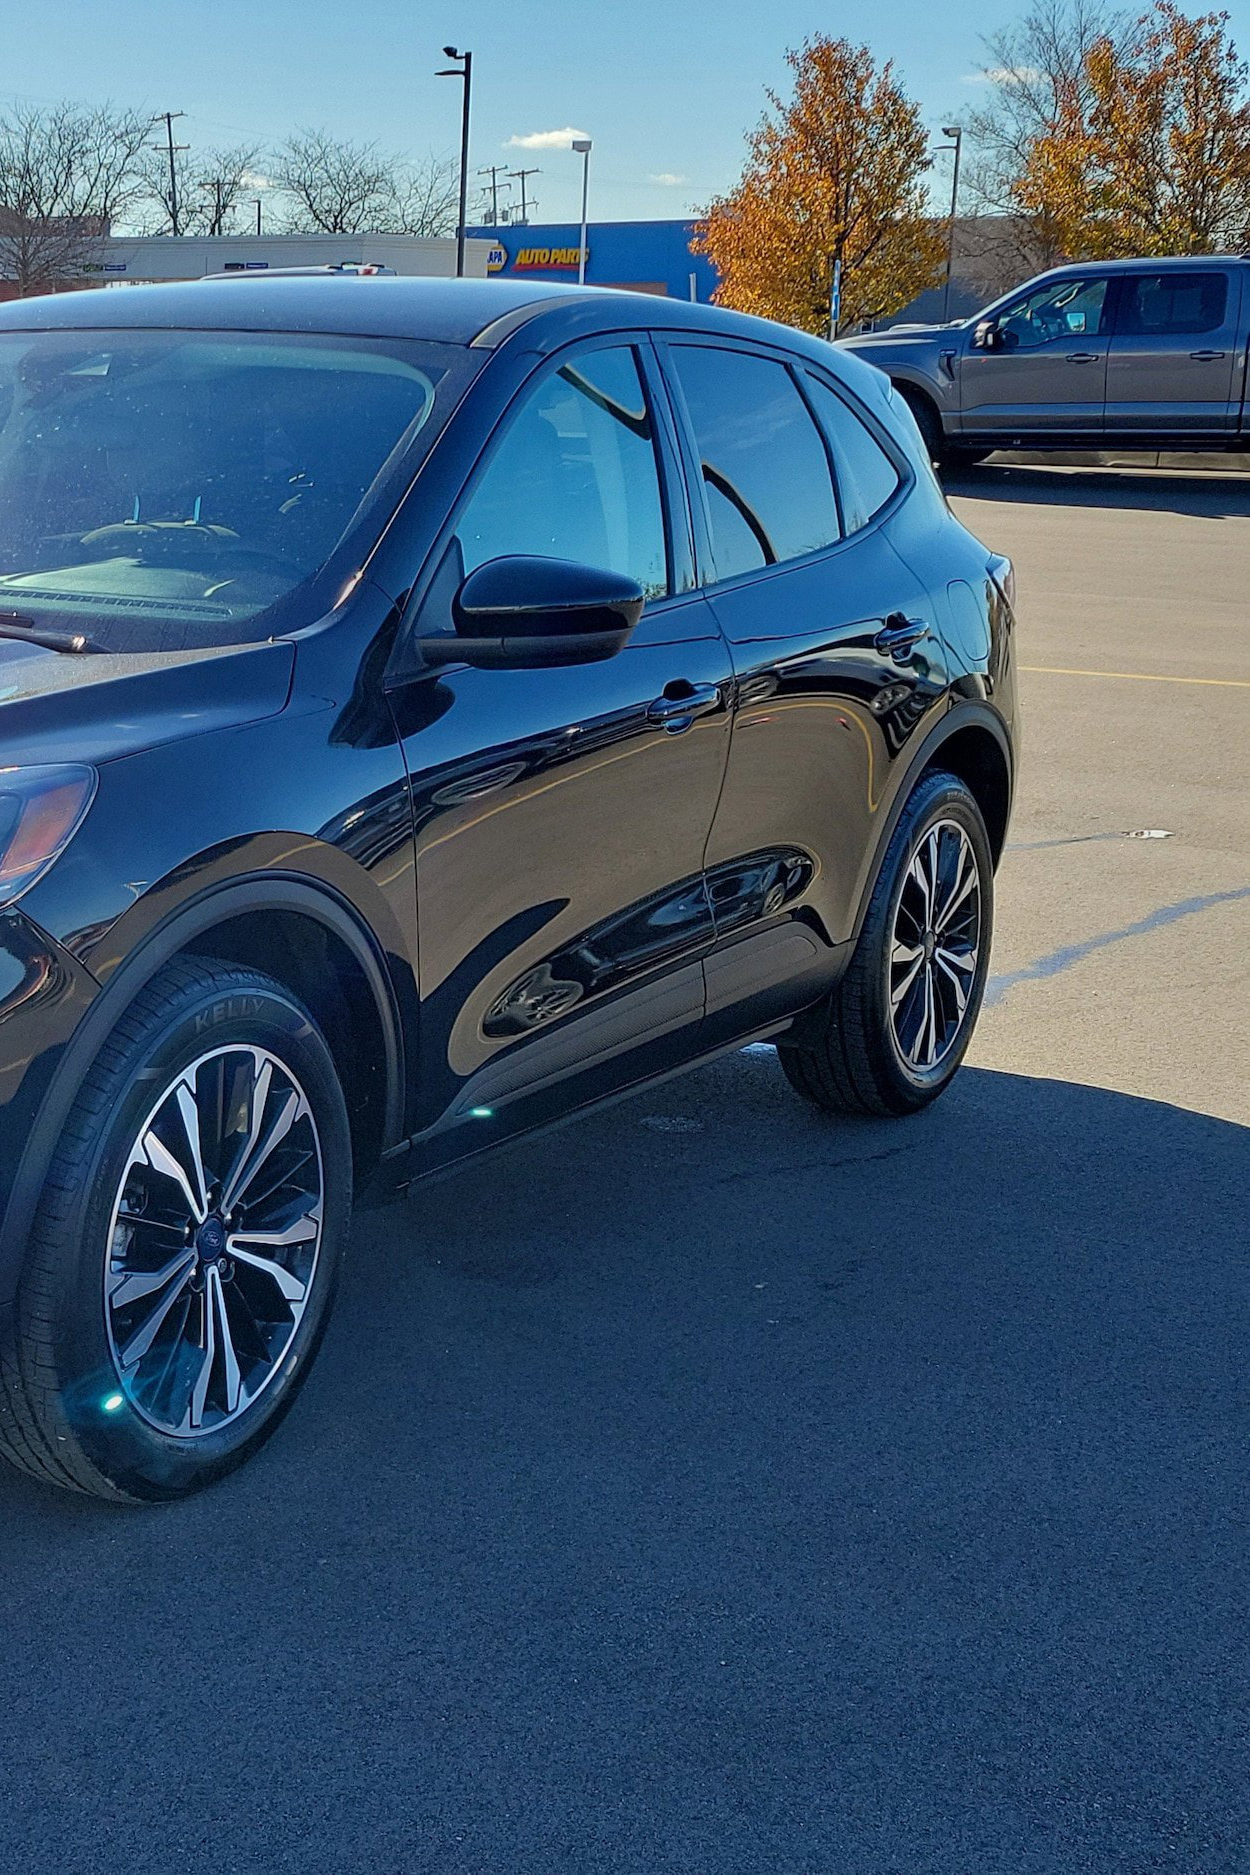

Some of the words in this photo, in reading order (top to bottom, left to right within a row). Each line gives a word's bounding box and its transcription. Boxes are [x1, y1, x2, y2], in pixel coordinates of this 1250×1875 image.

[487, 251, 503, 263] APA
[516, 249, 550, 263] AUTO
[195, 997, 265, 1033] KELLY
